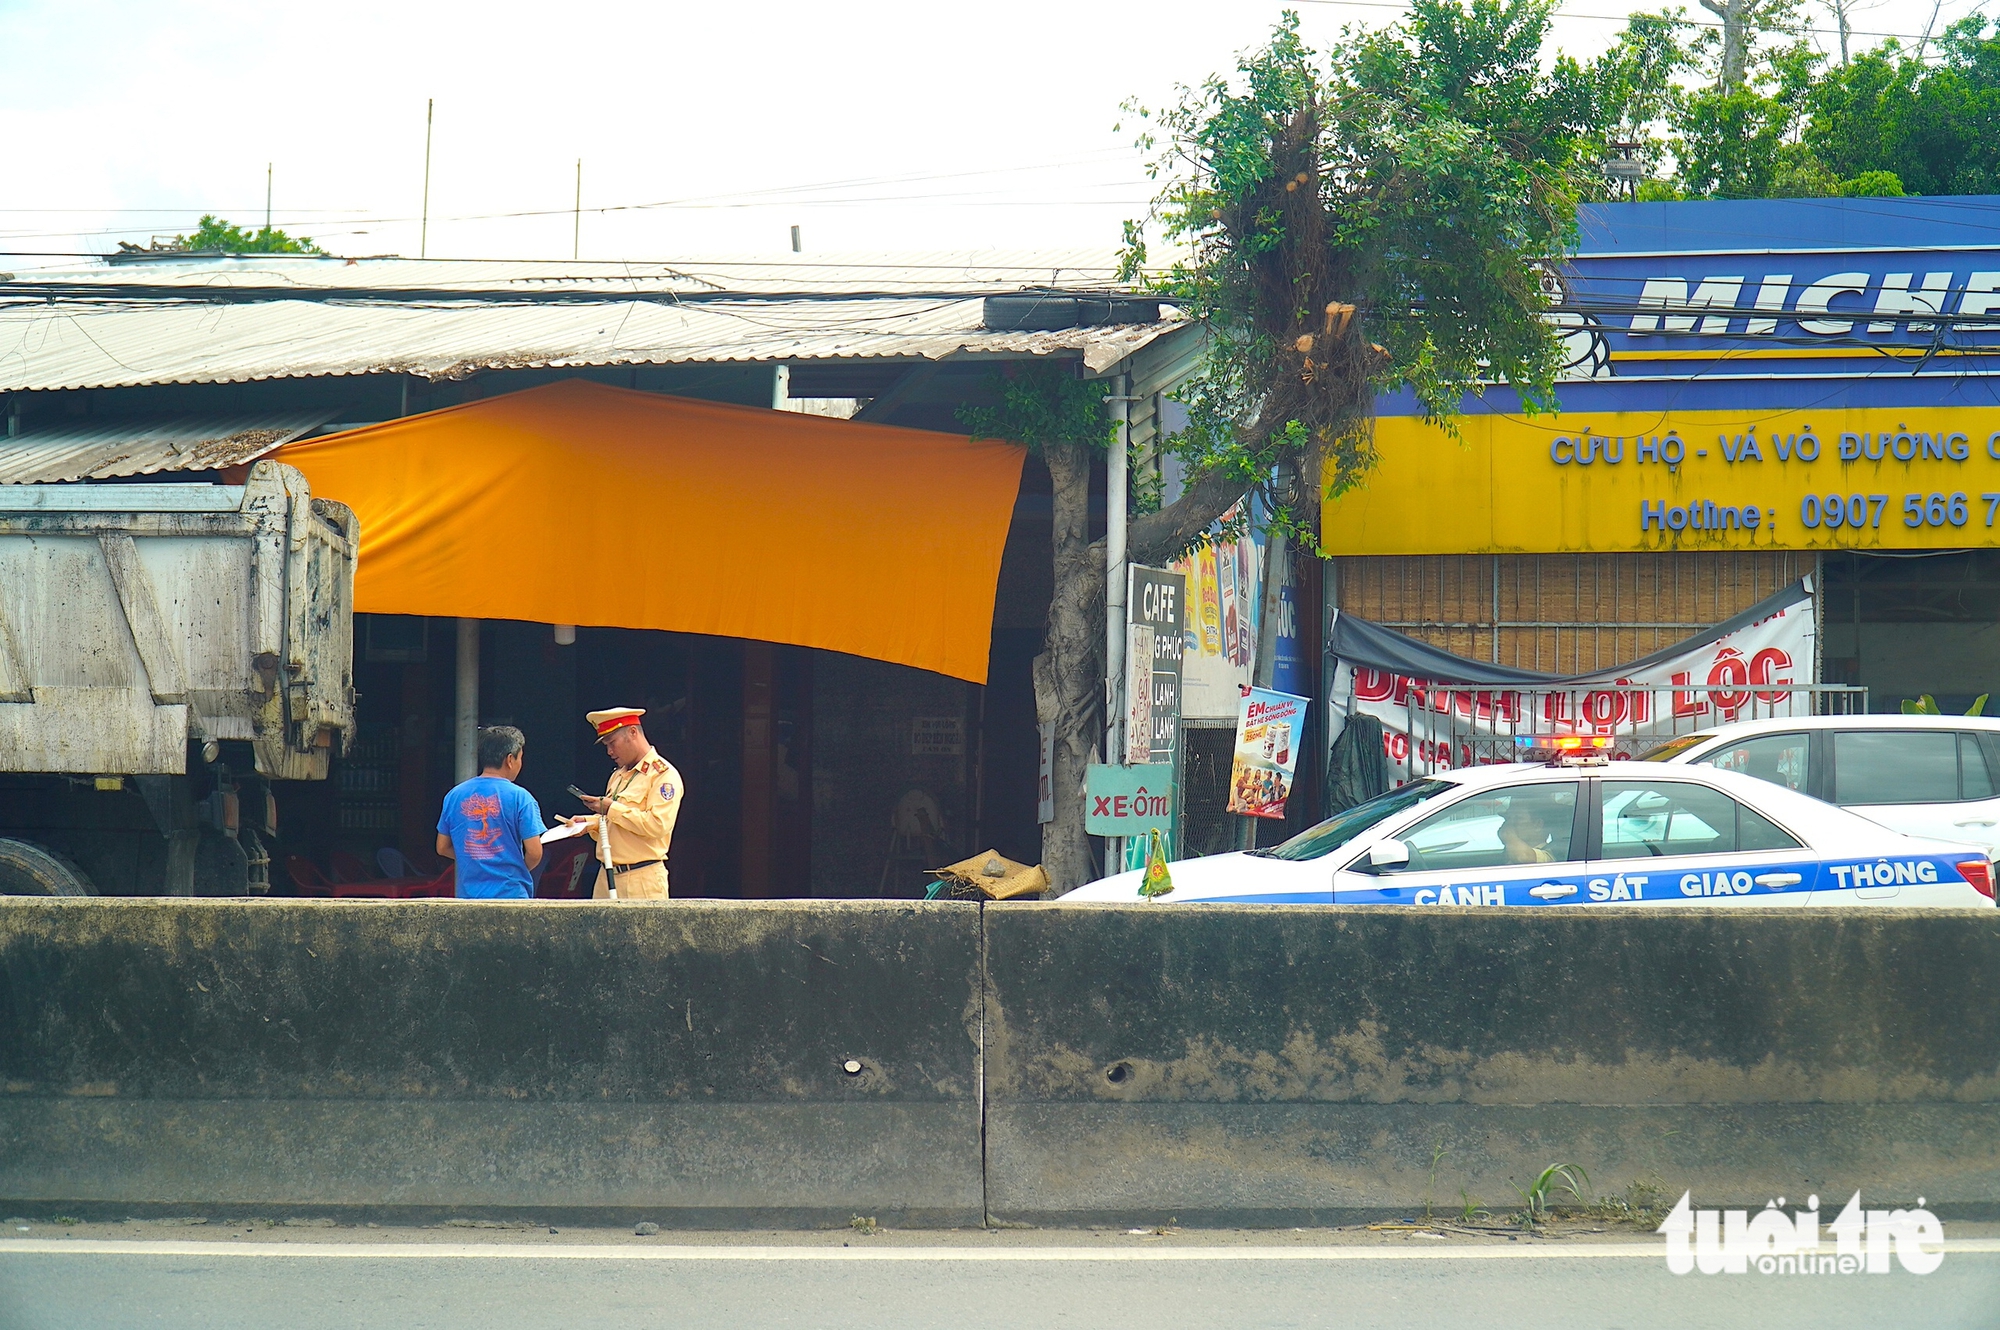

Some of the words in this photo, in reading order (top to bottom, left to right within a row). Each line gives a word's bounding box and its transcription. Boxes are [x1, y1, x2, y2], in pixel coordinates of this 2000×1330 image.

[1550, 426, 1624, 465] CỨU
[1637, 430, 1685, 473] HỘ
[1719, 425, 1763, 462] VÁ
[1772, 424, 1821, 462] VỎ
[1838, 423, 1970, 461] ĐƯỜNG
[1801, 494, 1889, 529] 0907
[1903, 492, 1968, 528] 566
[1143, 582, 1175, 623] CAFE
[1161, 630, 1182, 661] PHÚC
[1155, 683, 1175, 712] LẠNH
[1671, 647, 1793, 722] LỘC
[1155, 717, 1175, 745] LẠNH
[1588, 873, 1648, 901] SÁT
[1679, 872, 1753, 897] GIAO
[1829, 858, 1938, 888] THÔNG
